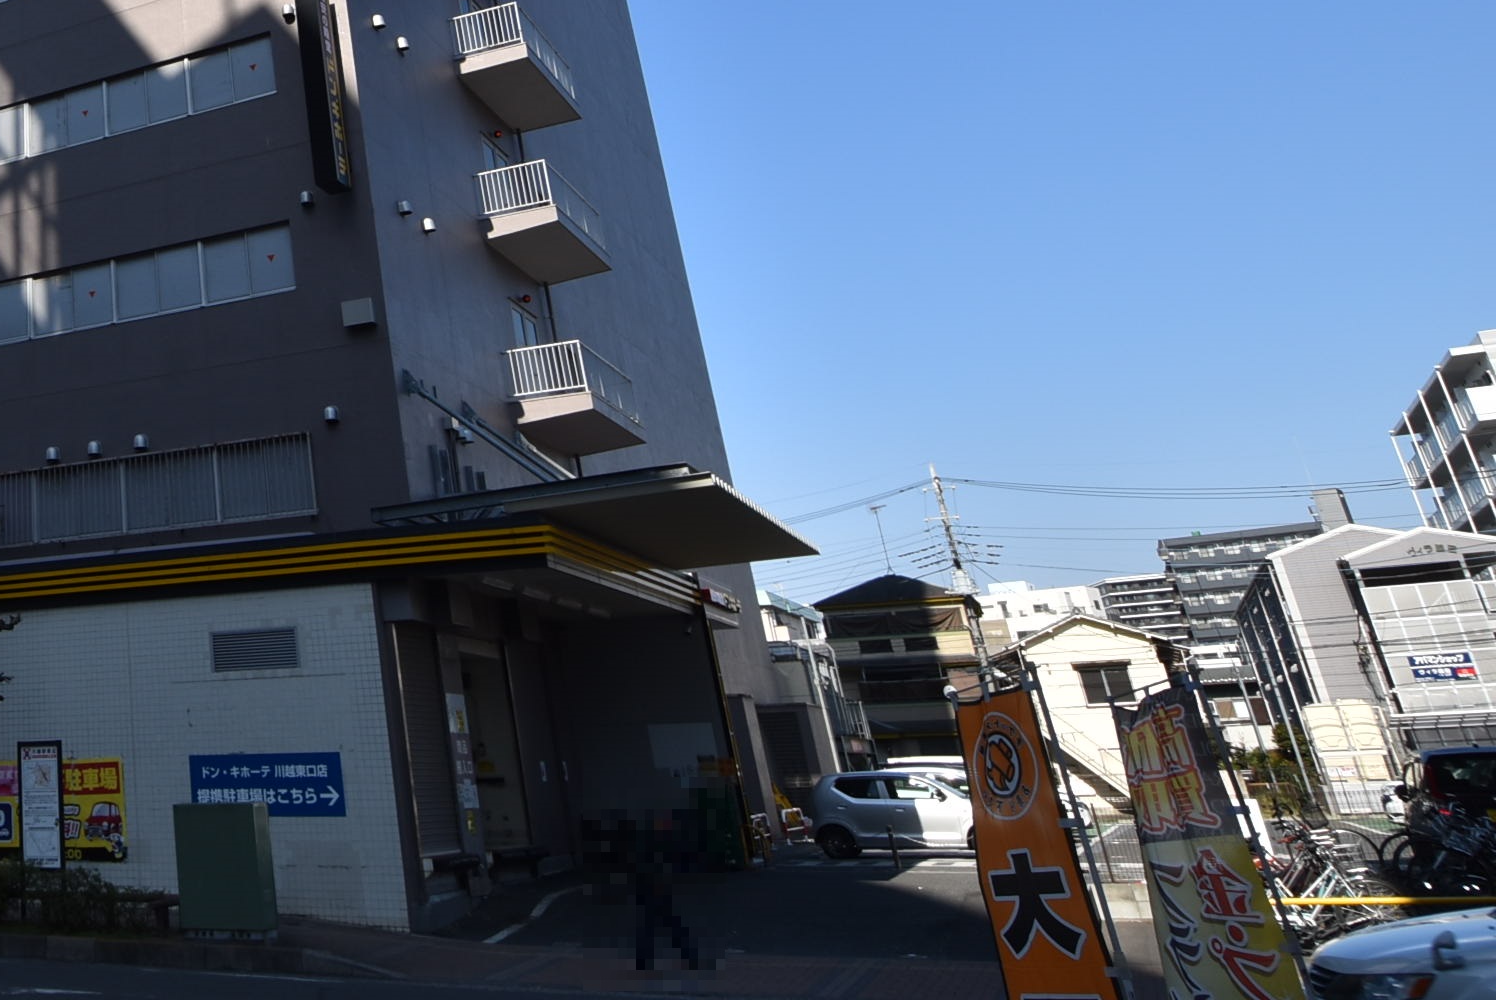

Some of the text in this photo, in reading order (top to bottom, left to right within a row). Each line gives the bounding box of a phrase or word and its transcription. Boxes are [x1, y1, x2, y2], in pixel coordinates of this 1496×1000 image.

[201, 763, 328, 779] ドン・キホーテ 川越東口店
[196, 787, 318, 804] 提携駐車場はこちら
